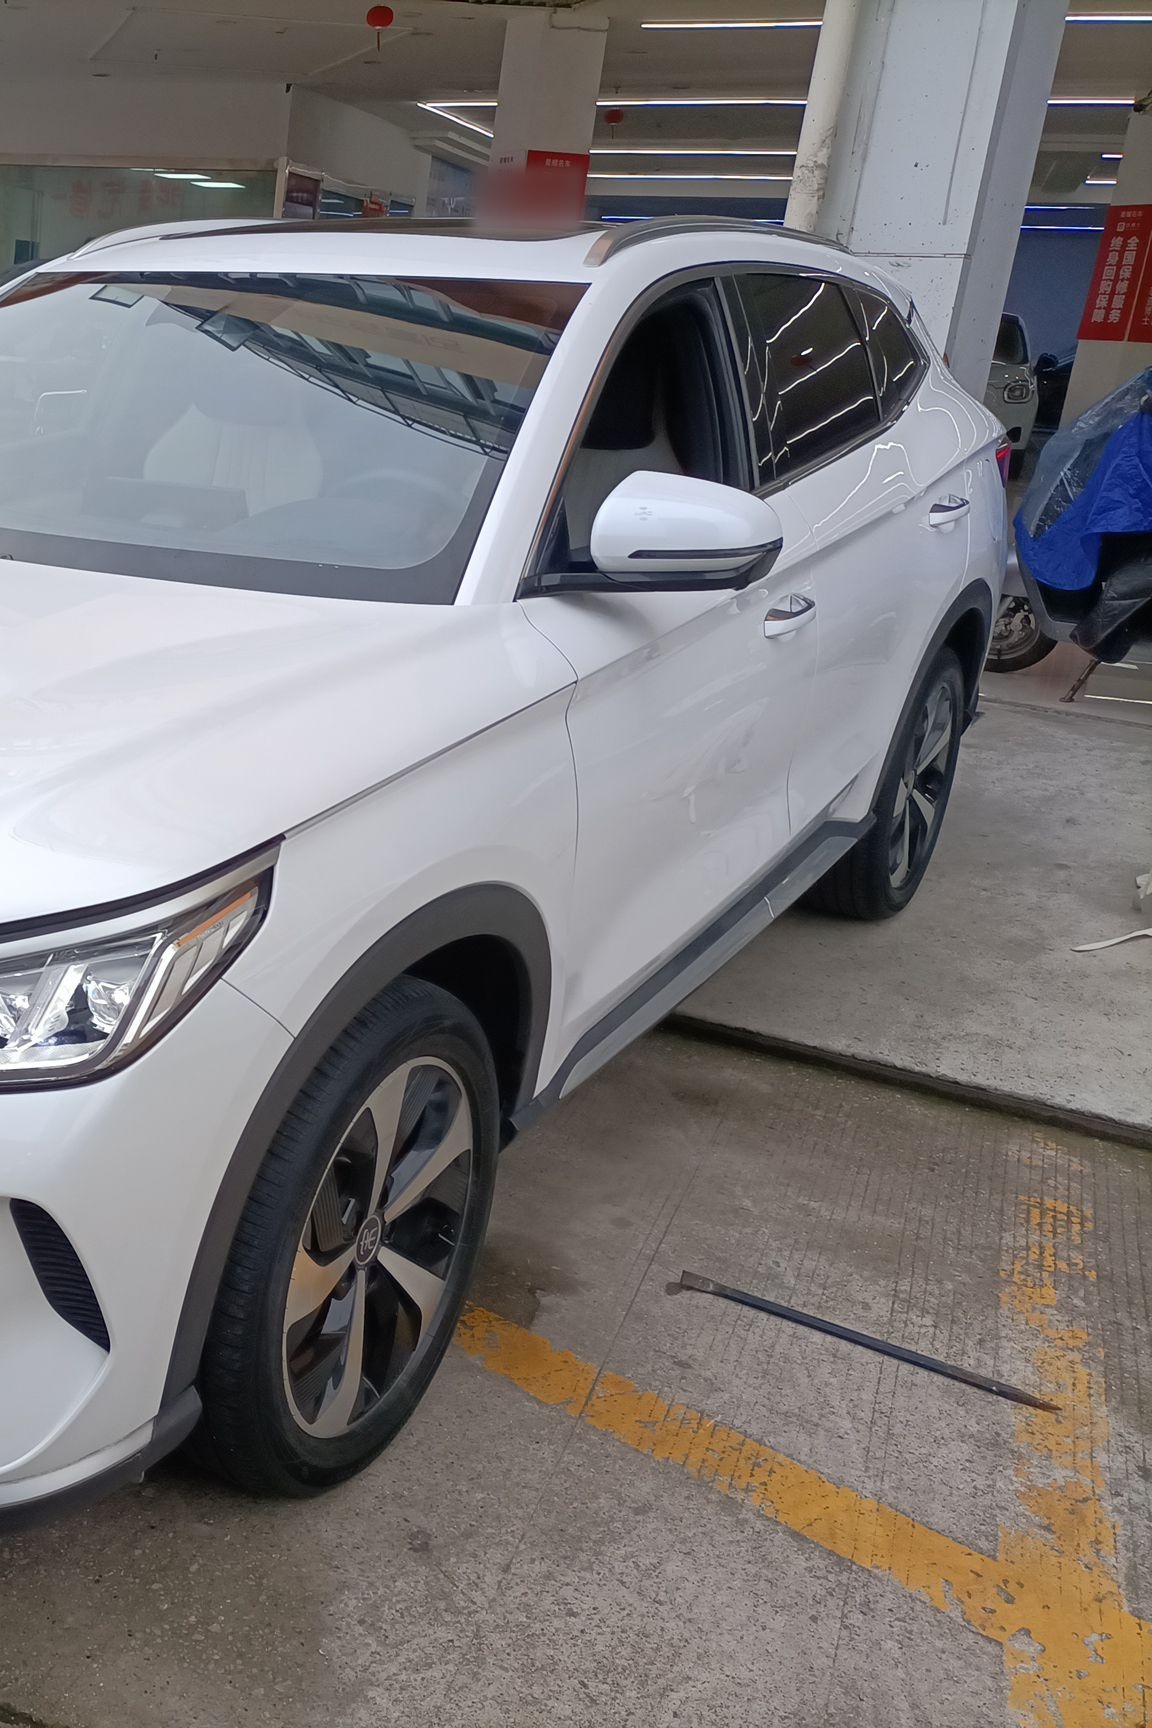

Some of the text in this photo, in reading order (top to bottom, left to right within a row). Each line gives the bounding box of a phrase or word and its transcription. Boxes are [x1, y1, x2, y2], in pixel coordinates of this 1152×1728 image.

[1091, 236, 1123, 323] 终身回购保障
[1107, 236, 1139, 323] 全国保修服务
